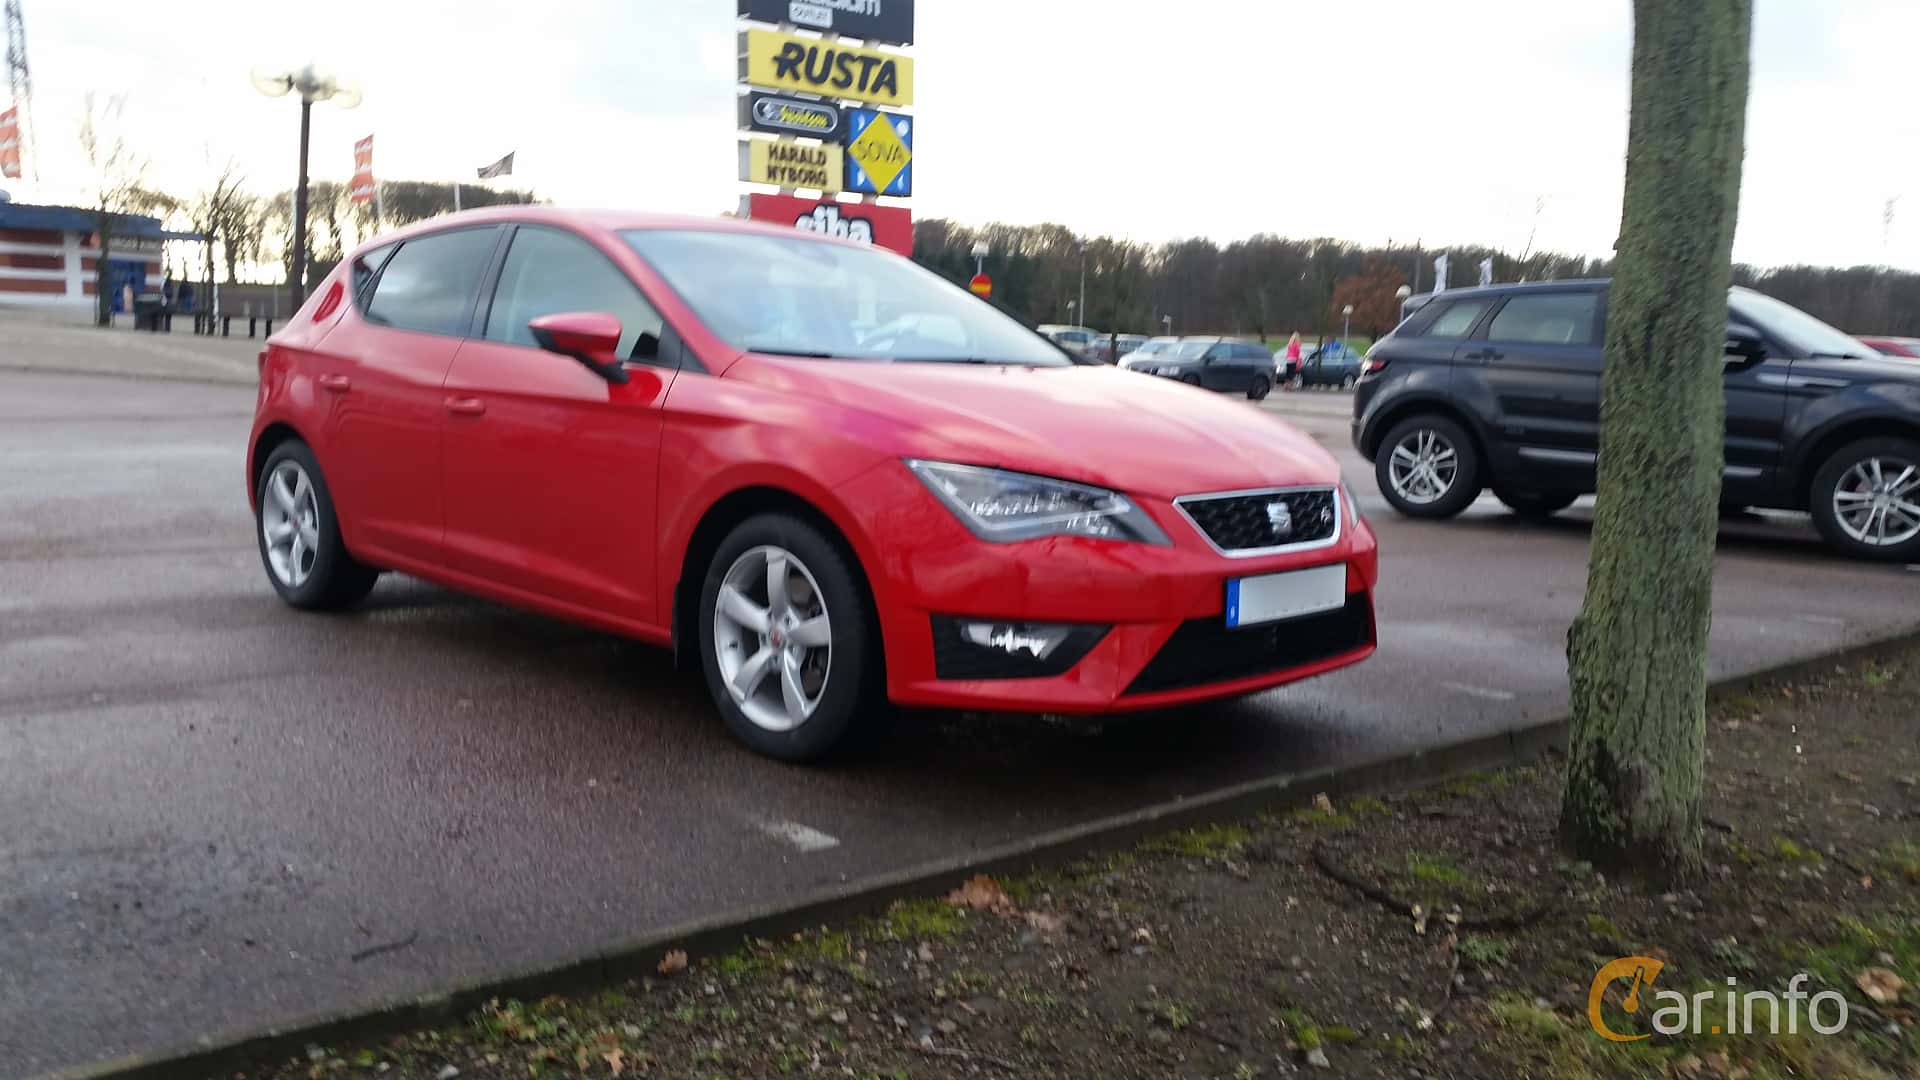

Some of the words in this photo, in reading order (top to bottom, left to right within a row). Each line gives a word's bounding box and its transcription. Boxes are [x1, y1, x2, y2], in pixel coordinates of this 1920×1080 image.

[772, 42, 897, 97] RUSTA
[768, 144, 827, 166] HARALD
[856, 140, 904, 164] SOVA
[767, 164, 827, 188] NYBORG
